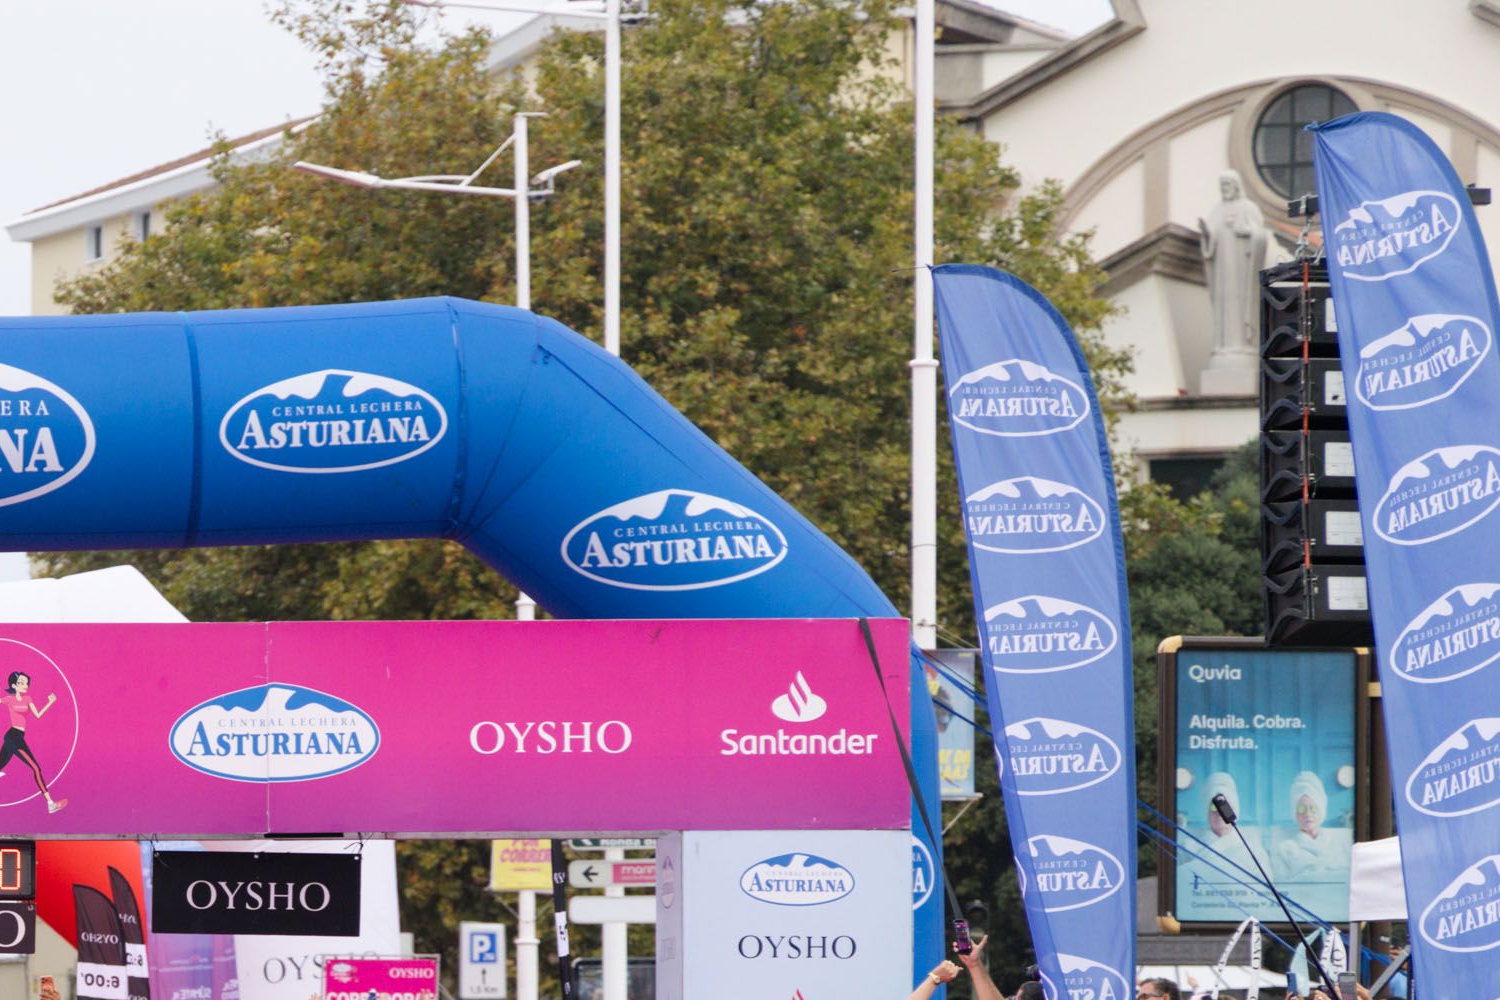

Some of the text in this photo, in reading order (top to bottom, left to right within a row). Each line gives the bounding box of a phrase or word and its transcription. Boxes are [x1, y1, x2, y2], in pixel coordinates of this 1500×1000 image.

[272, 400, 423, 418] CENTRAL LECHERA
[236, 408, 431, 450] ASTURIANA
[613, 519, 763, 539] CENTRAL LECHERA
[580, 531, 777, 569] ASTURIANA
[1188, 664, 1242, 684] Quvia
[218, 717, 357, 728] CENTRAL LECHERA
[1189, 714, 1307, 732] Alquila. Cobra.
[186, 718, 364, 758] ASTURIANA
[469, 720, 633, 755] OYSHO
[720, 727, 878, 756] Santander
[1189, 734, 1259, 750] Disfruta.
[749, 872, 847, 893] ASTURIANA
[186, 879, 331, 913] OYSHO
[738, 935, 857, 959] OYSHO
[388, 967, 434, 979] OYSHO
